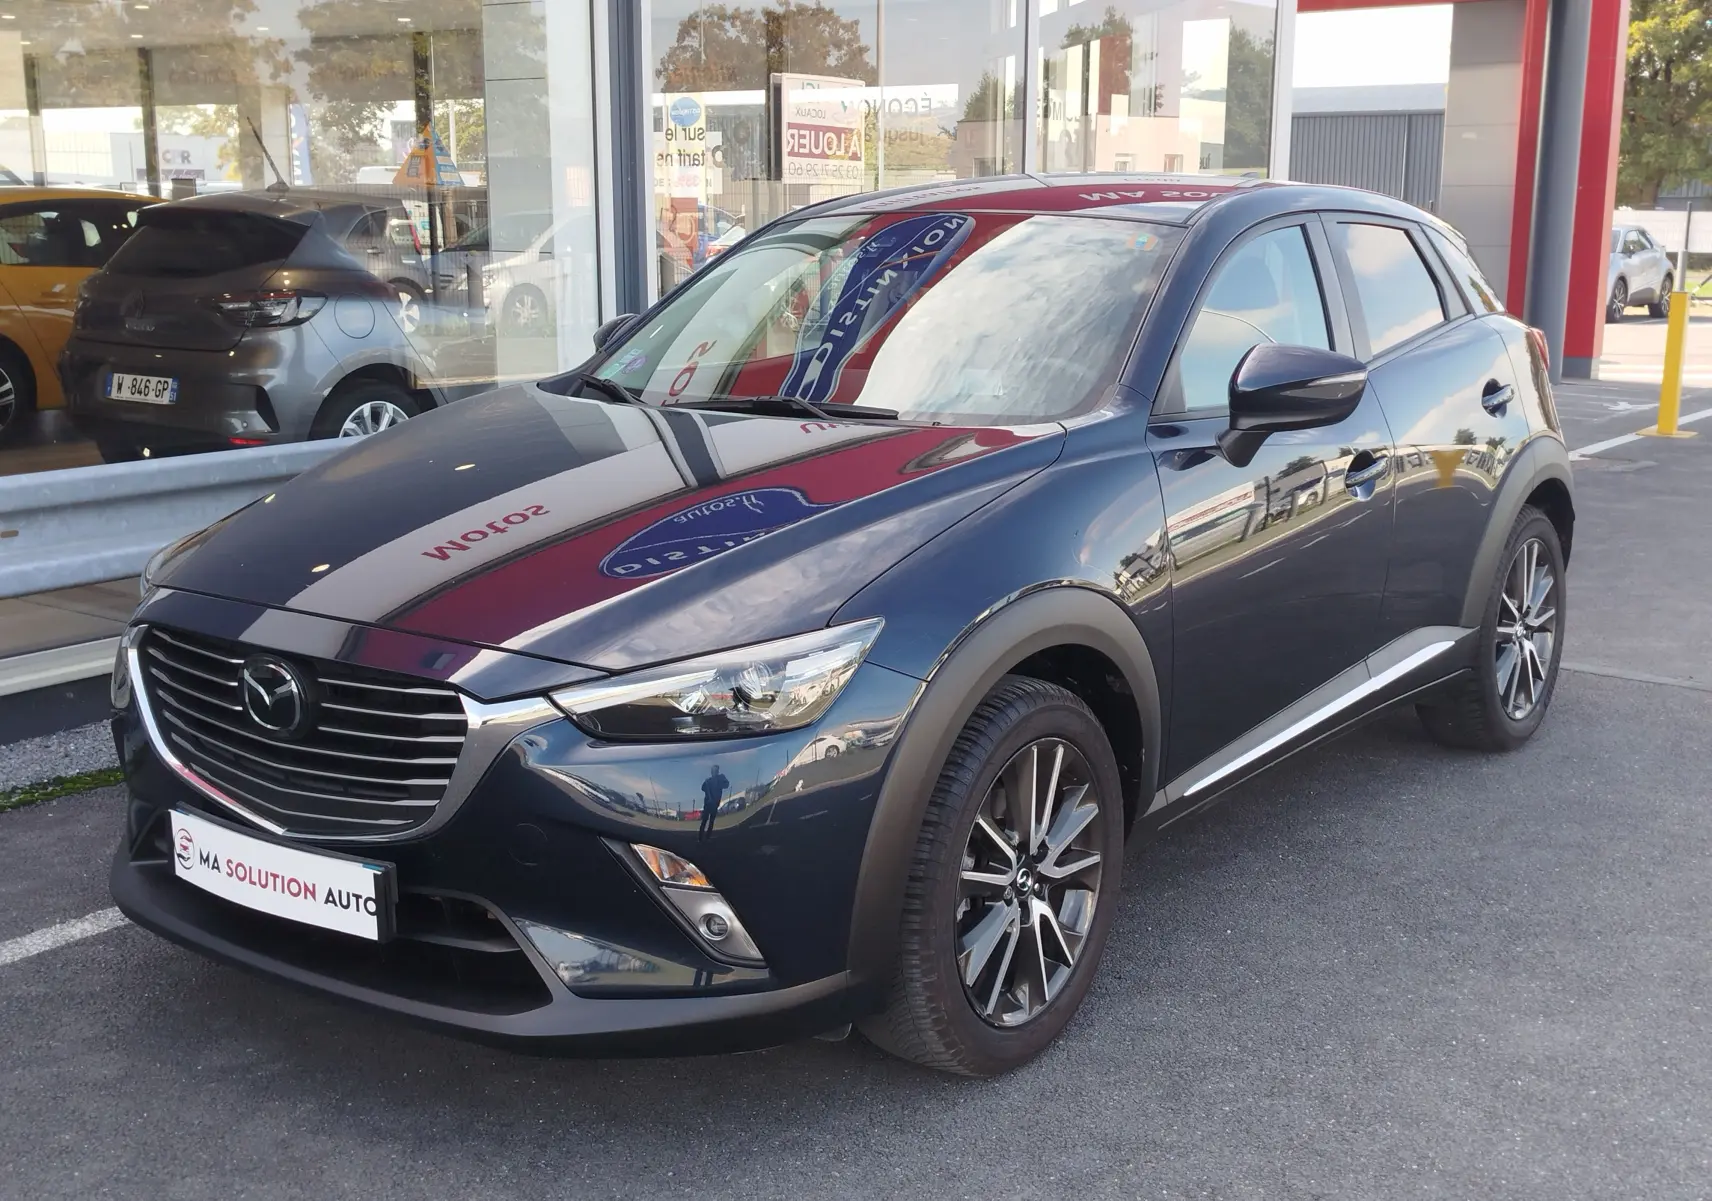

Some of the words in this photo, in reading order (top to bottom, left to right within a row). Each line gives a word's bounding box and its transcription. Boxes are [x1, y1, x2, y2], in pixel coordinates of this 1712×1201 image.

[199, 847, 221, 874] MA
[226, 858, 317, 902] SOLUTION
[323, 886, 379, 917] AUTO
